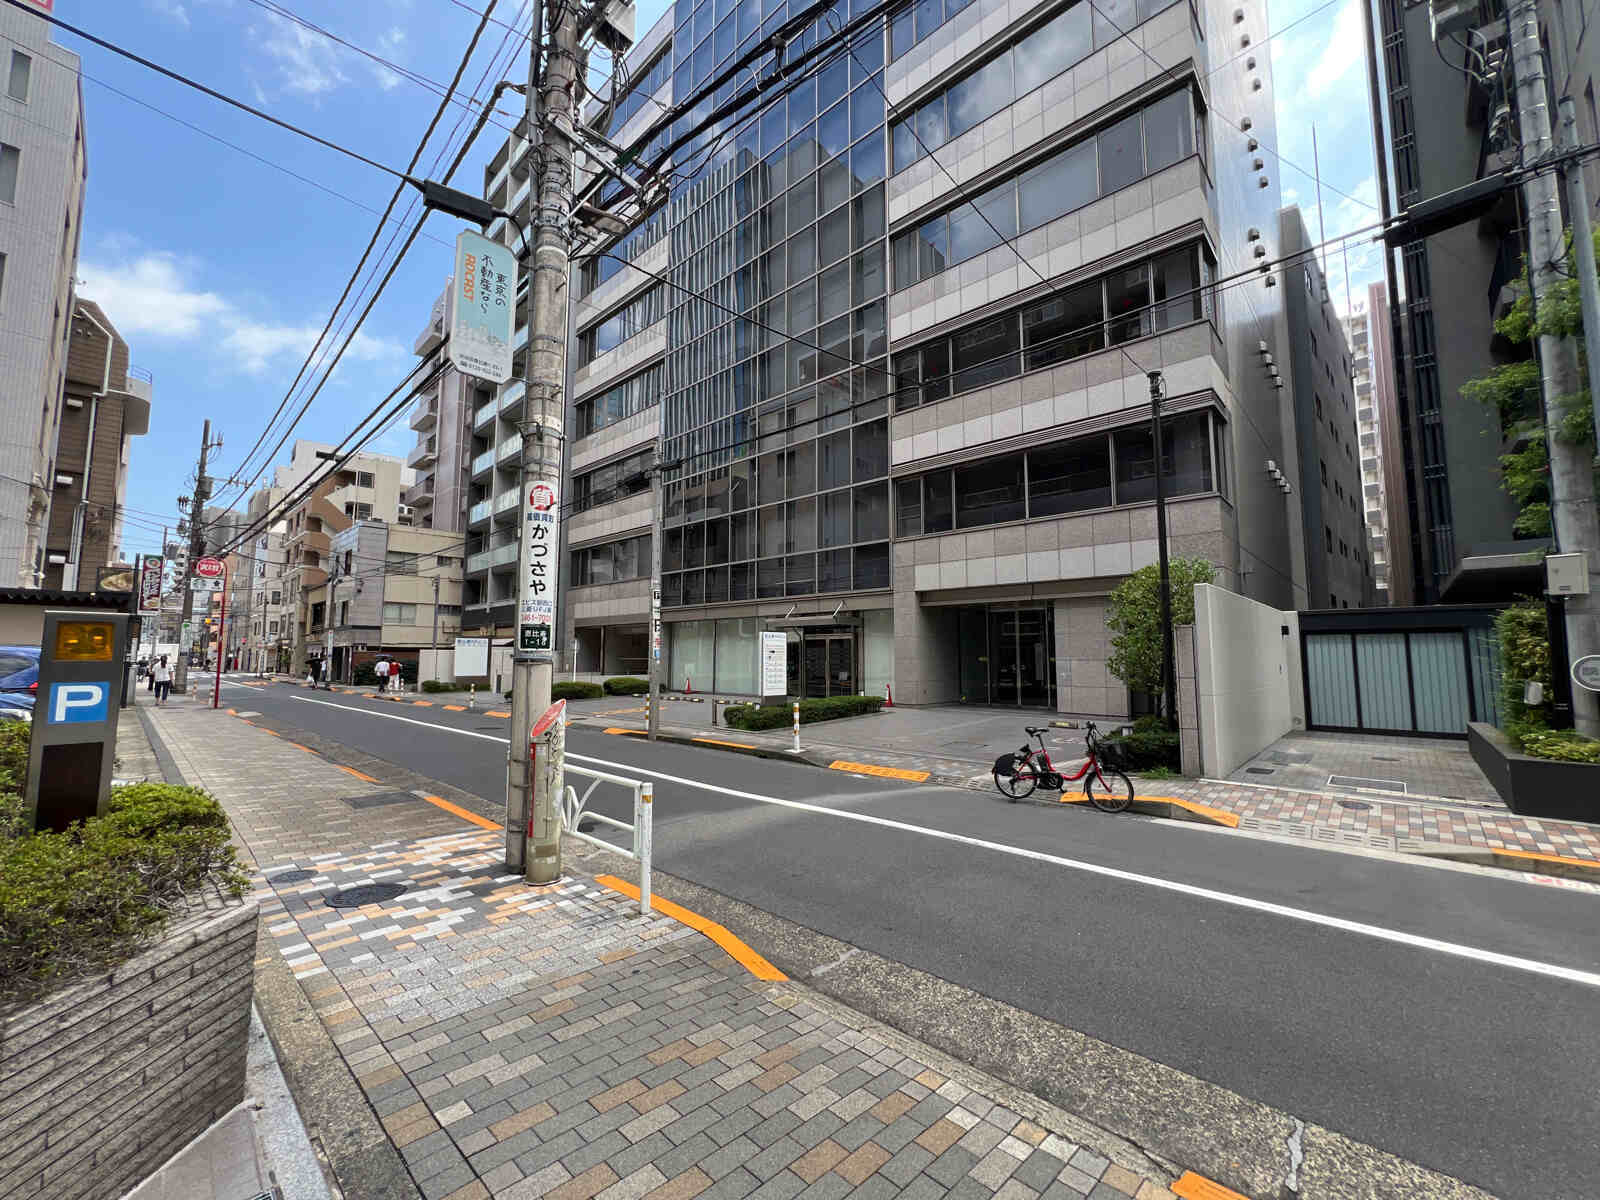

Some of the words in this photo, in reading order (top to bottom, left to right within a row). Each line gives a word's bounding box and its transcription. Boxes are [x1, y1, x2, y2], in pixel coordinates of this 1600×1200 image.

[495, 272, 507, 307] 東京の
[529, 523, 549, 596] かづさや
[55, 685, 103, 721] P
